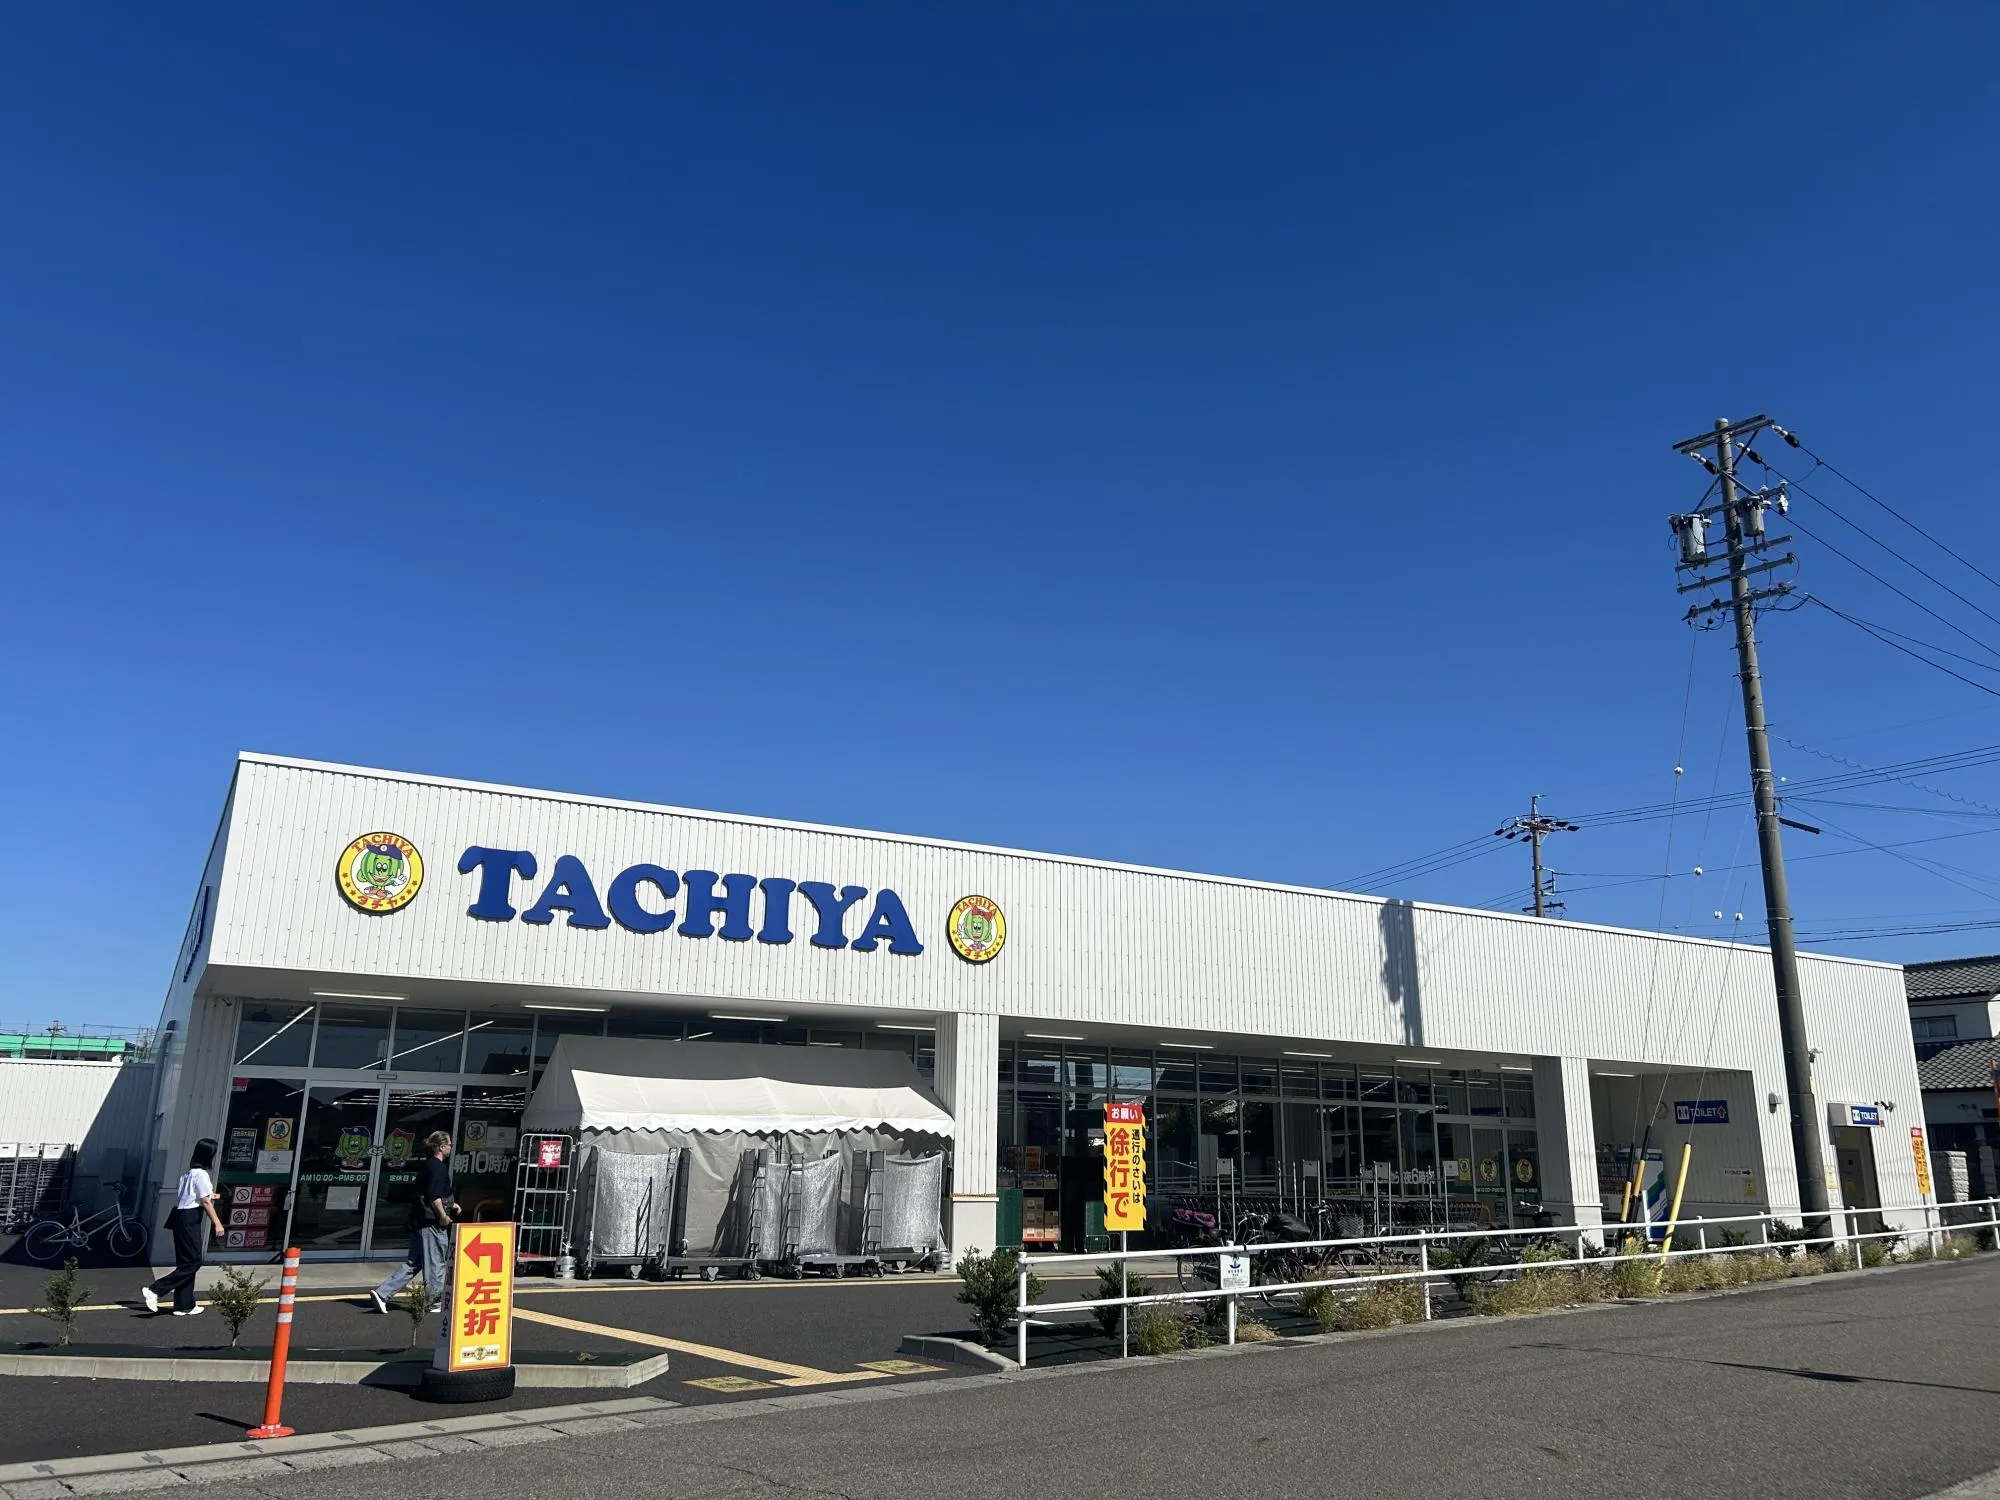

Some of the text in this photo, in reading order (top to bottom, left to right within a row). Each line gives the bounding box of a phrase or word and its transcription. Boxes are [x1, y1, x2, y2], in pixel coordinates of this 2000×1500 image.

[352, 834, 414, 859] TACHIYA
[457, 845, 924, 956] TACHIYA
[1111, 1107, 1138, 1120] お願い
[1689, 1107, 1718, 1117] TOILET
[1861, 1111, 1878, 1120] TOILET
[1109, 1127, 1130, 1218] 徐行で
[1131, 1129, 1141, 1204] 通行のさいは
[463, 1278, 502, 1336] 左折
